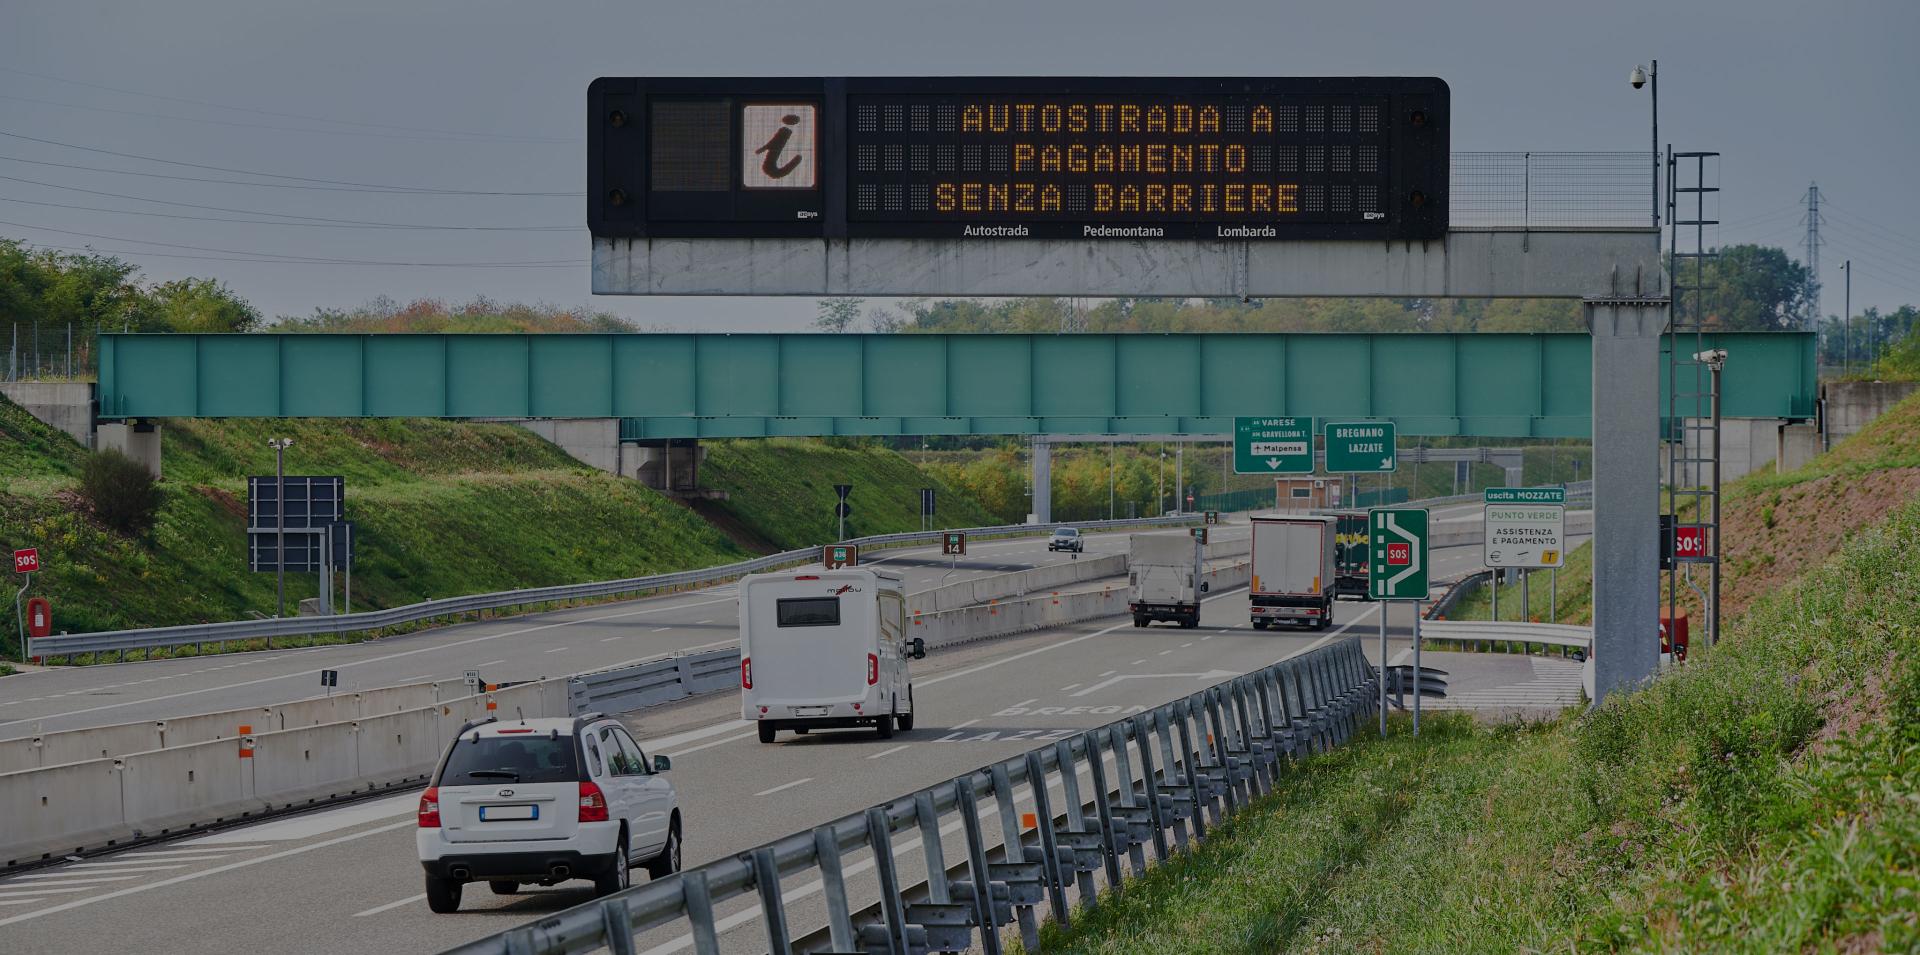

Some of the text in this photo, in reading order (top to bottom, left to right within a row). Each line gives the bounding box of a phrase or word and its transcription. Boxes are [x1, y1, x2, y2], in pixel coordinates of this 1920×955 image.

[962, 104, 1273, 133] AUTOSTRADA A
[1013, 143, 1247, 173] PAGAMENTO
[935, 183, 1299, 212] SENZA BARRIERE
[963, 224, 1276, 237] Autostrada Pedemontana Lombarda
[1262, 419, 1296, 427] VARESE
[1261, 430, 1301, 438] GRAVELLONA
[1336, 428, 1384, 438] BREGNANO
[1264, 445, 1302, 453] Malpensa
[1348, 443, 1384, 453] LAZZATE
[1487, 491, 1562, 500] uscita MOZZATE
[1491, 511, 1558, 519] PUNTO VERDE
[948, 544, 960, 553] 14
[1675, 536, 1702, 551] SOS
[1389, 549, 1407, 559] SOS
[17, 555, 36, 567] SOS
